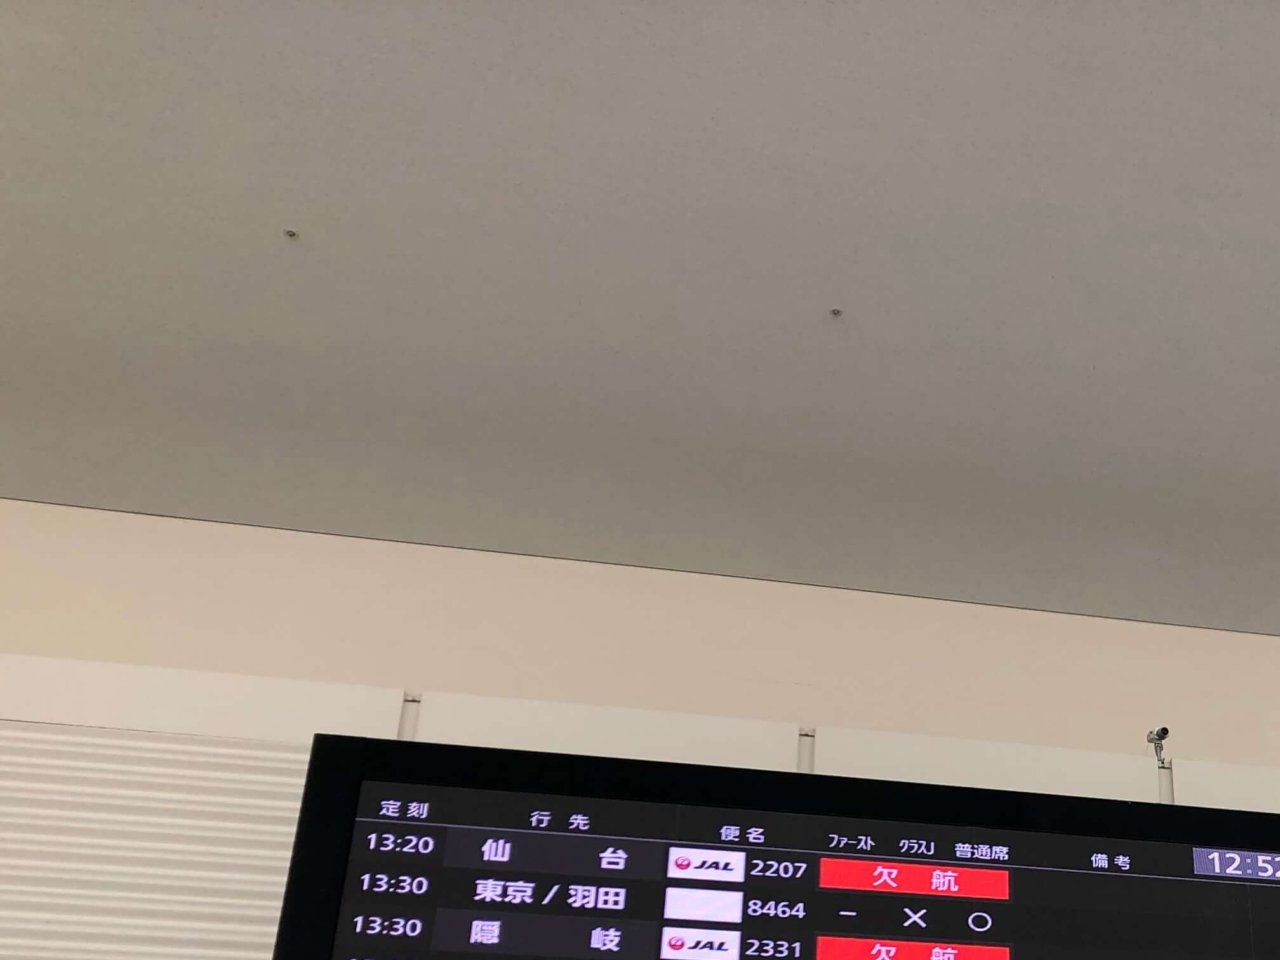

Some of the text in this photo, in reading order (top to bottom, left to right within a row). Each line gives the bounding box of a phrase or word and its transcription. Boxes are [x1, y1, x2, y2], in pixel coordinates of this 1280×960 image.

[368, 833, 434, 853] 13:20
[693, 860, 735, 872] JAL
[750, 860, 807, 878] 2207
[361, 874, 428, 894] 13:30
[747, 900, 806, 918] 8464
[354, 916, 422, 936] 13:30
[687, 940, 730, 952] JAL
[745, 940, 800, 957] 2331
